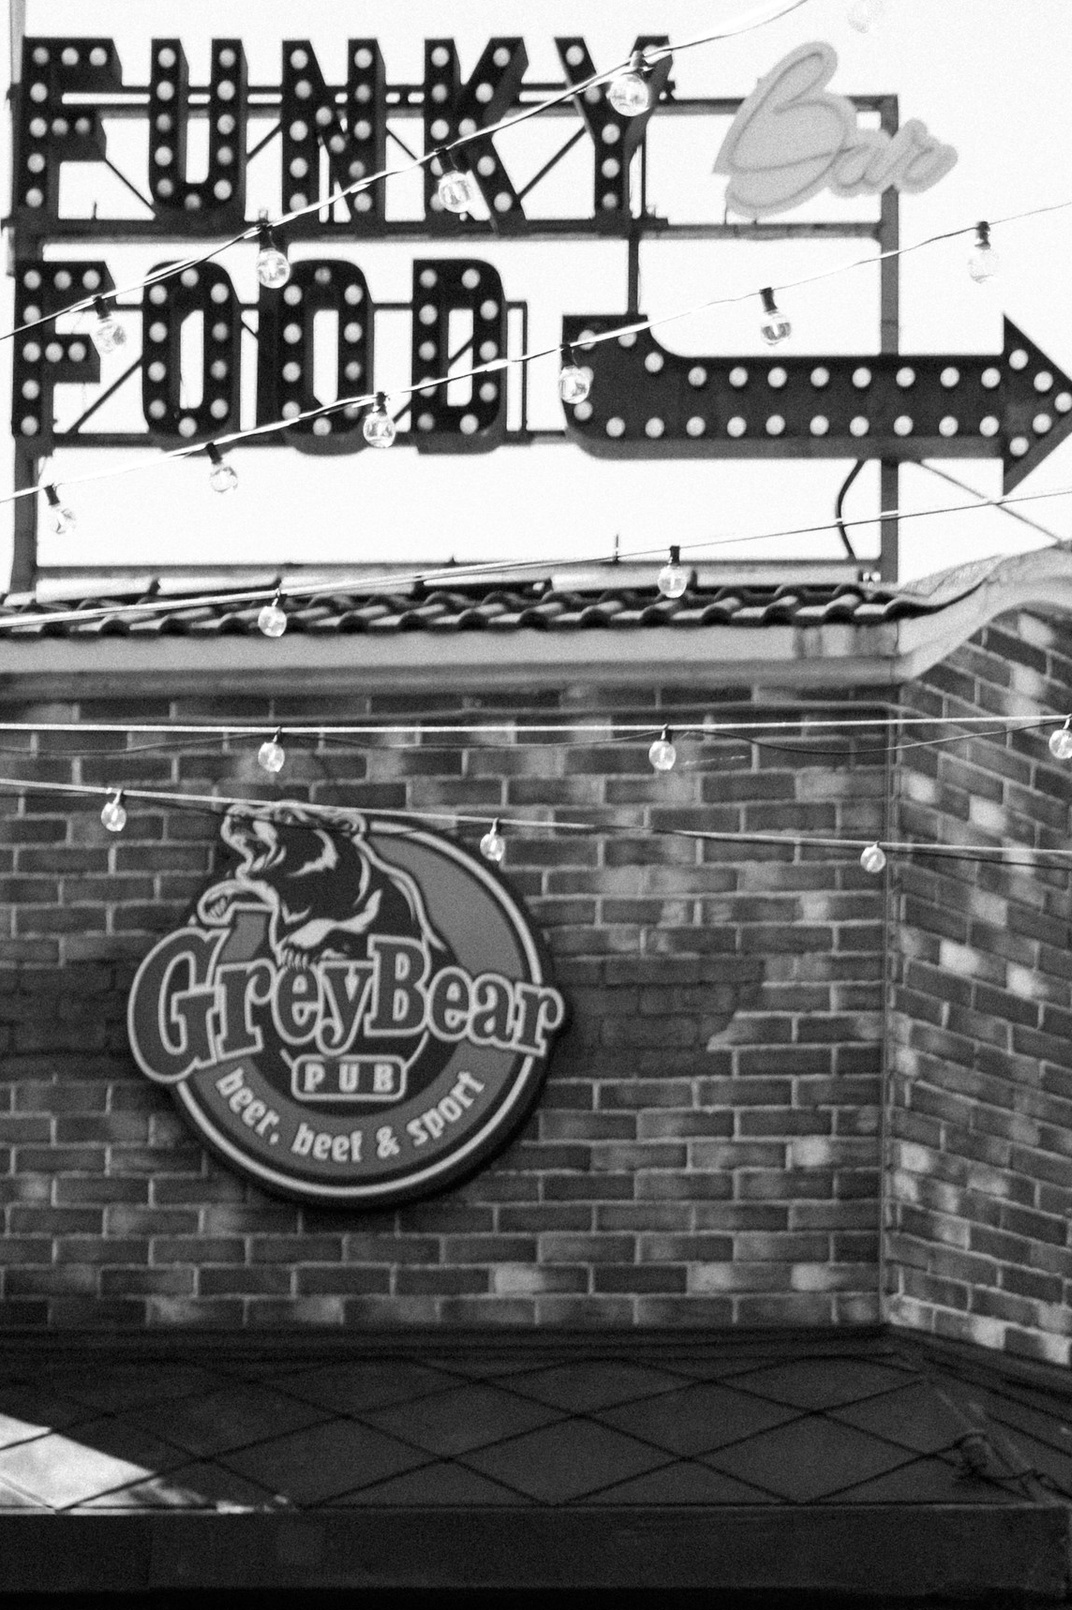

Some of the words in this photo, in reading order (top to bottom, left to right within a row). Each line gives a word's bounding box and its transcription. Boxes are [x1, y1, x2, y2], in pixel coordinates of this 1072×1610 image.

[14, 35, 673, 222] FUNKY
[716, 44, 957, 216] Bar
[12, 258, 506, 454] FOOD
[127, 926, 565, 1083] GreyBear
[304, 1061, 396, 1094] PUB
[215, 1067, 280, 1145] beer,
[291, 1122, 363, 1163] beef
[376, 1126, 400, 1159] &
[405, 1069, 487, 1147] sport
